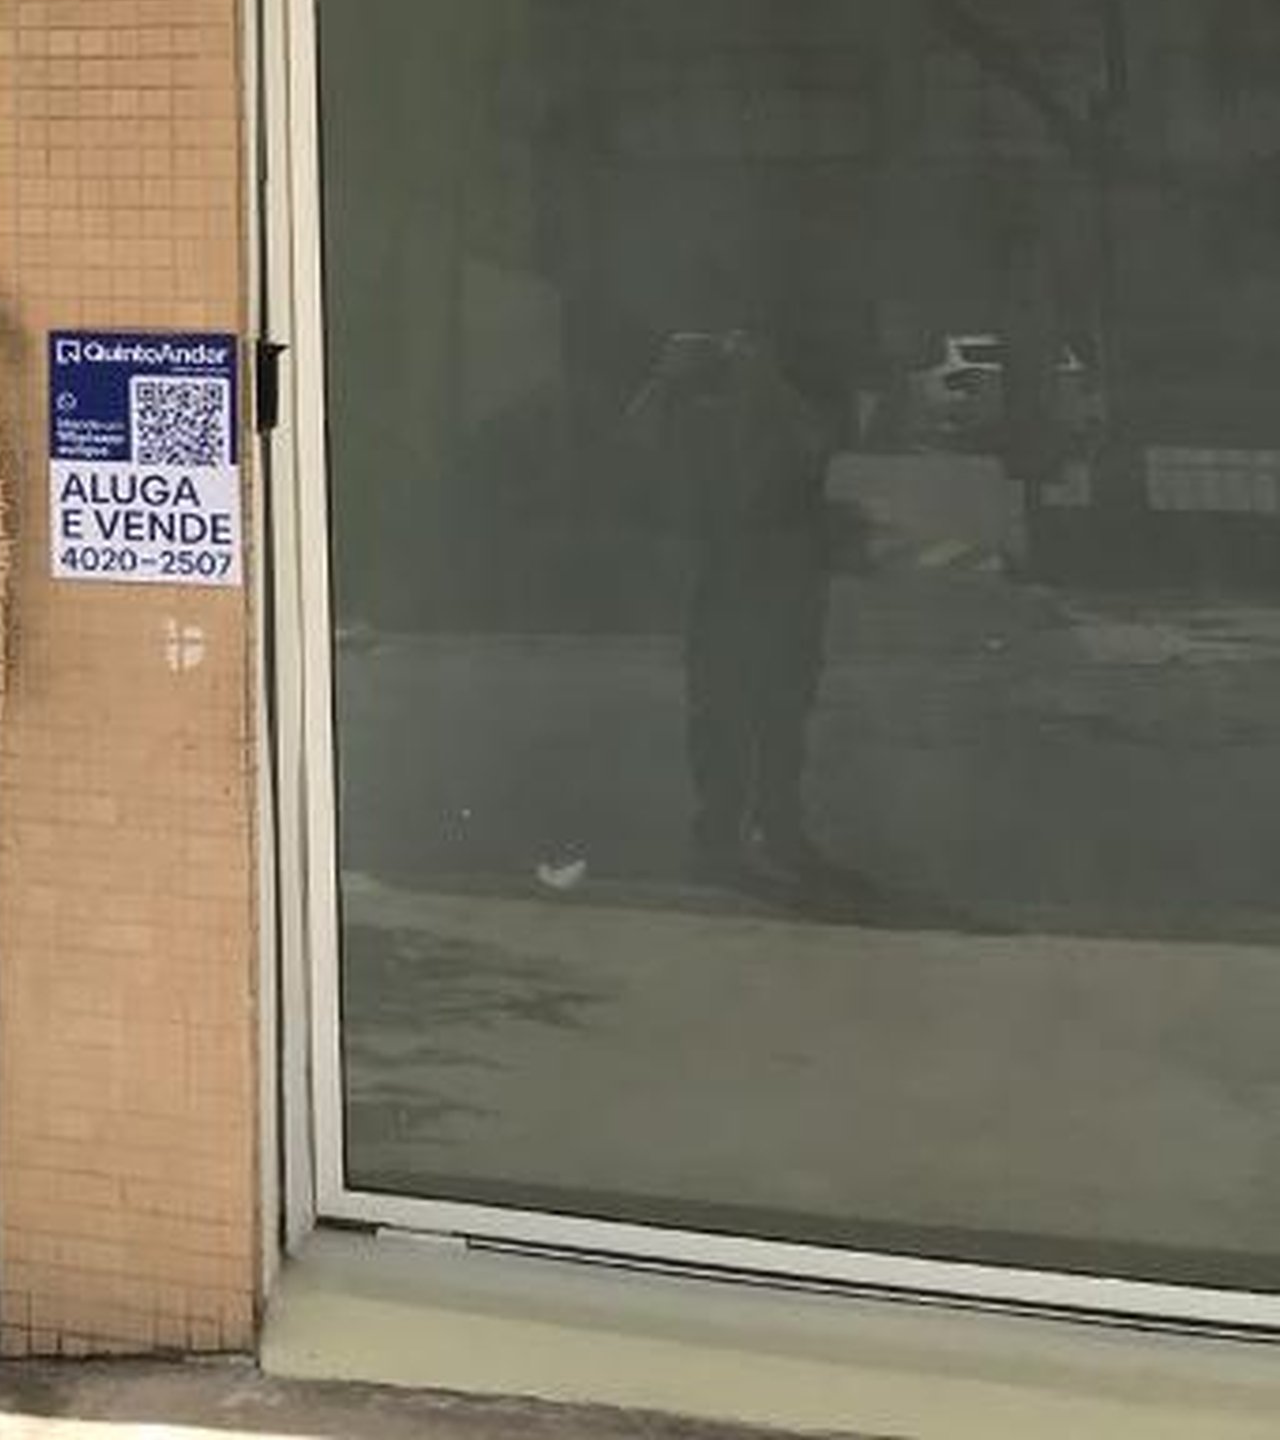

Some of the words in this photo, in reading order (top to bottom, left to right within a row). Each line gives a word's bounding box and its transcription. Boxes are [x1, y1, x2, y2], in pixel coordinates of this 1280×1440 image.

[61, 474, 201, 507] ALUGA
[63, 510, 83, 539] E
[94, 510, 232, 545] VENDE
[60, 546, 232, 577] 4020-2507
